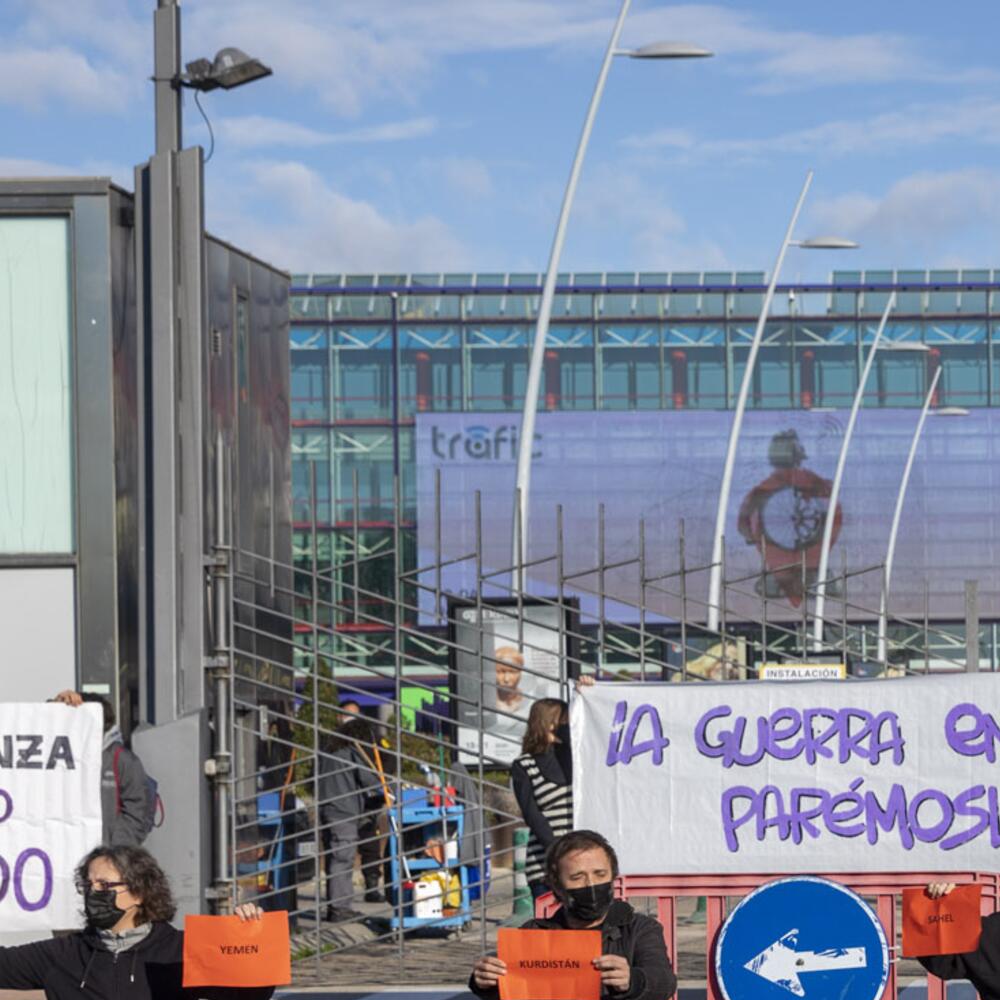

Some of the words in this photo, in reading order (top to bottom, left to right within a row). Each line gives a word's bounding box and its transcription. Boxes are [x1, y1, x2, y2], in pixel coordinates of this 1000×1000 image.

[766, 667, 838, 679] INSTALACIÓN
[927, 913, 955, 925] SAHEL
[220, 944, 259, 956] YEMEN
[519, 957, 581, 970] KURDISTÁN
